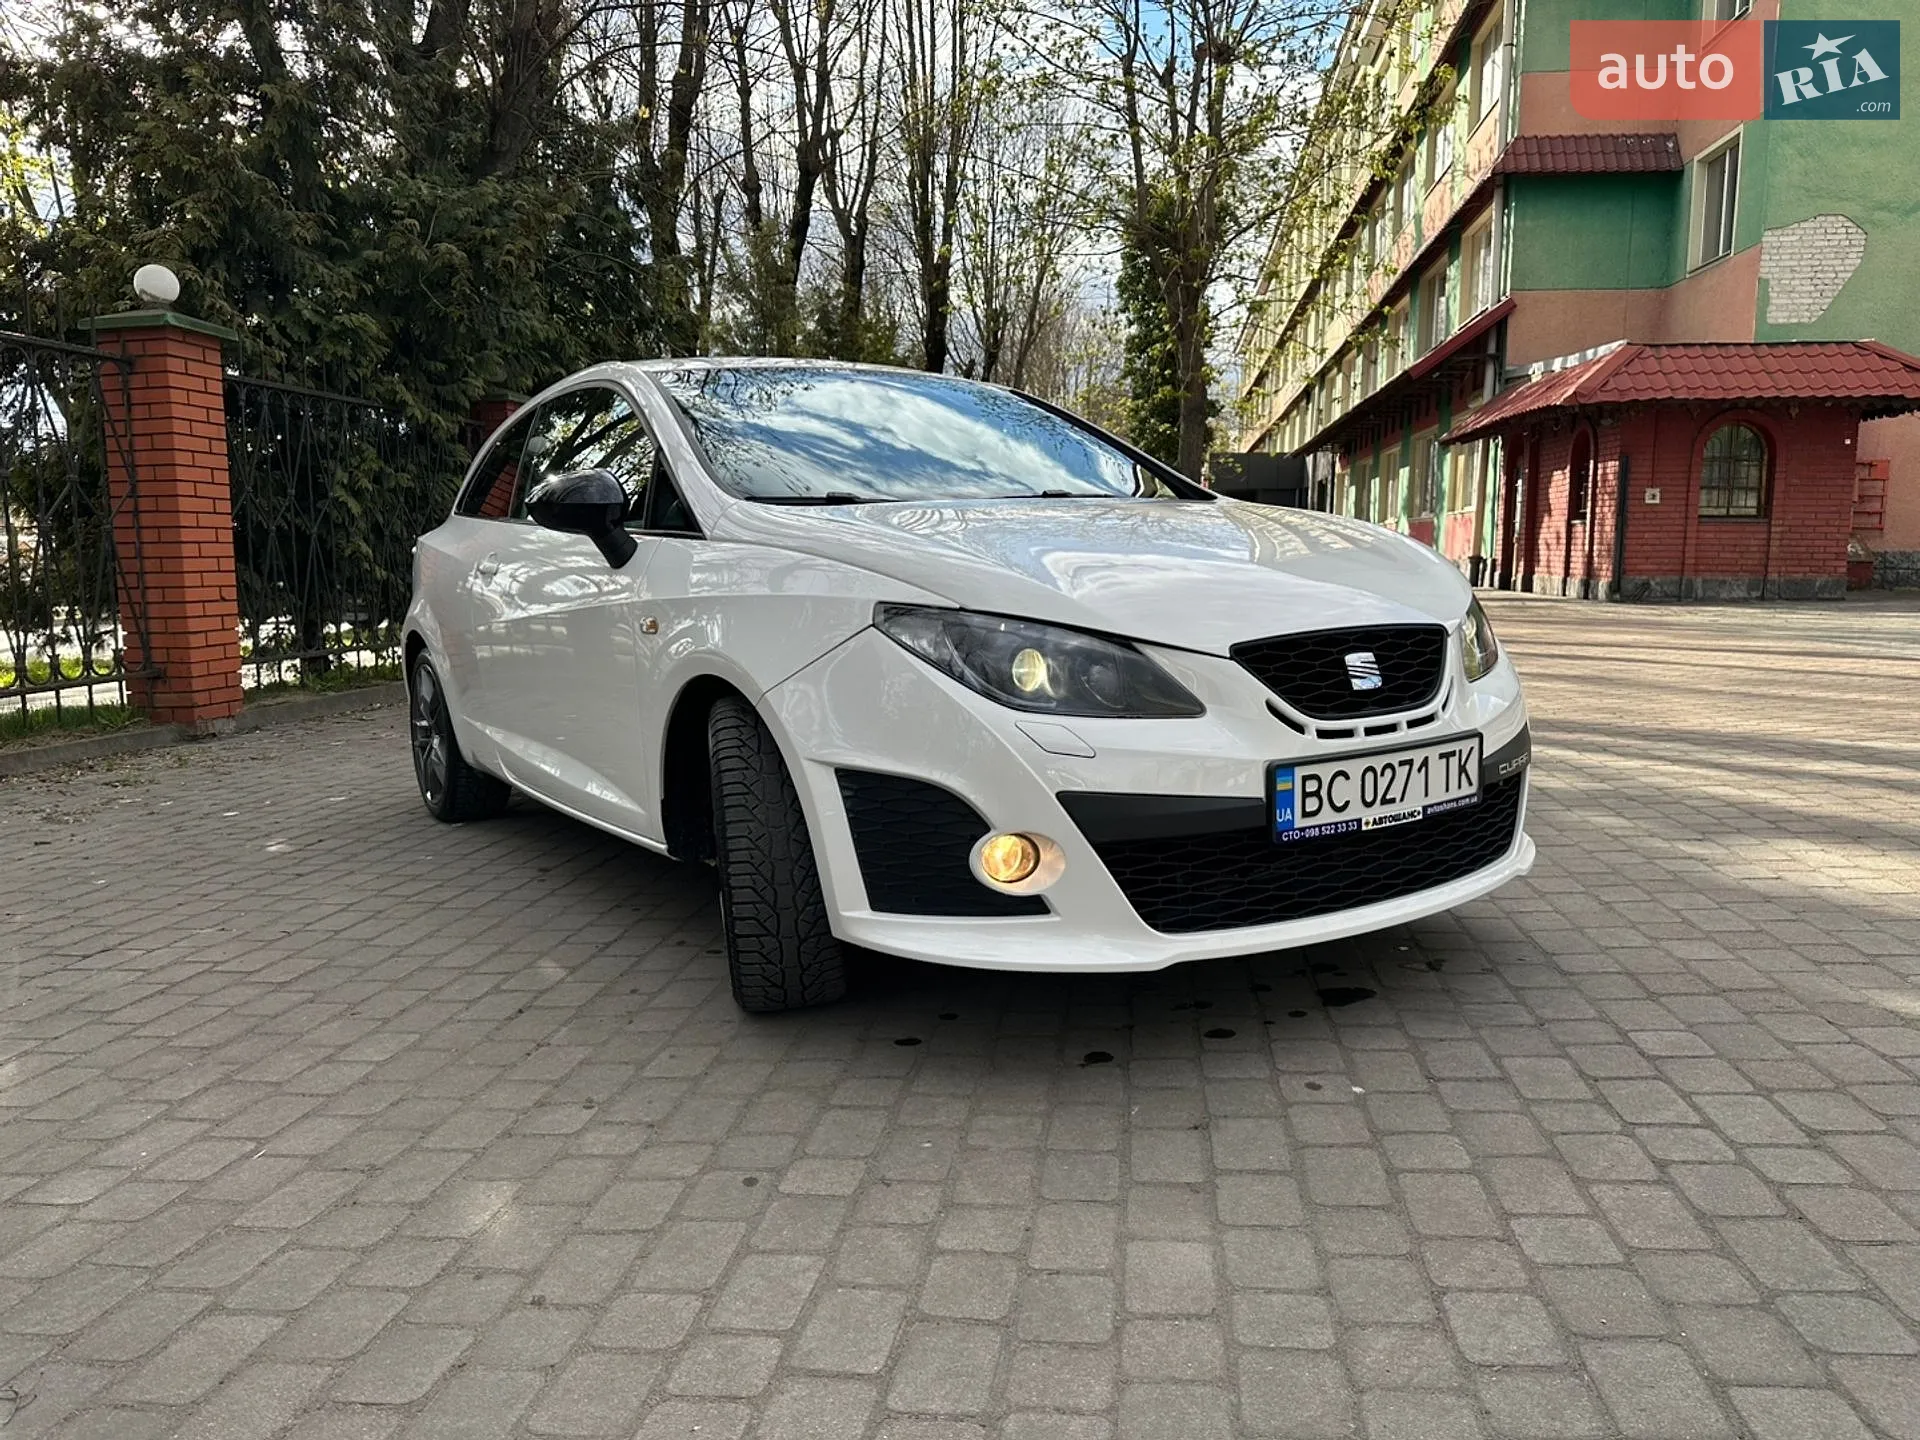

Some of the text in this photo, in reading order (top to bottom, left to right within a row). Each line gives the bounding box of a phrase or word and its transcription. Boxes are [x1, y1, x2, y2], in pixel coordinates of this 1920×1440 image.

[1300, 745, 1475, 819] BC 0271 TK
[1276, 808, 1293, 822] UA
